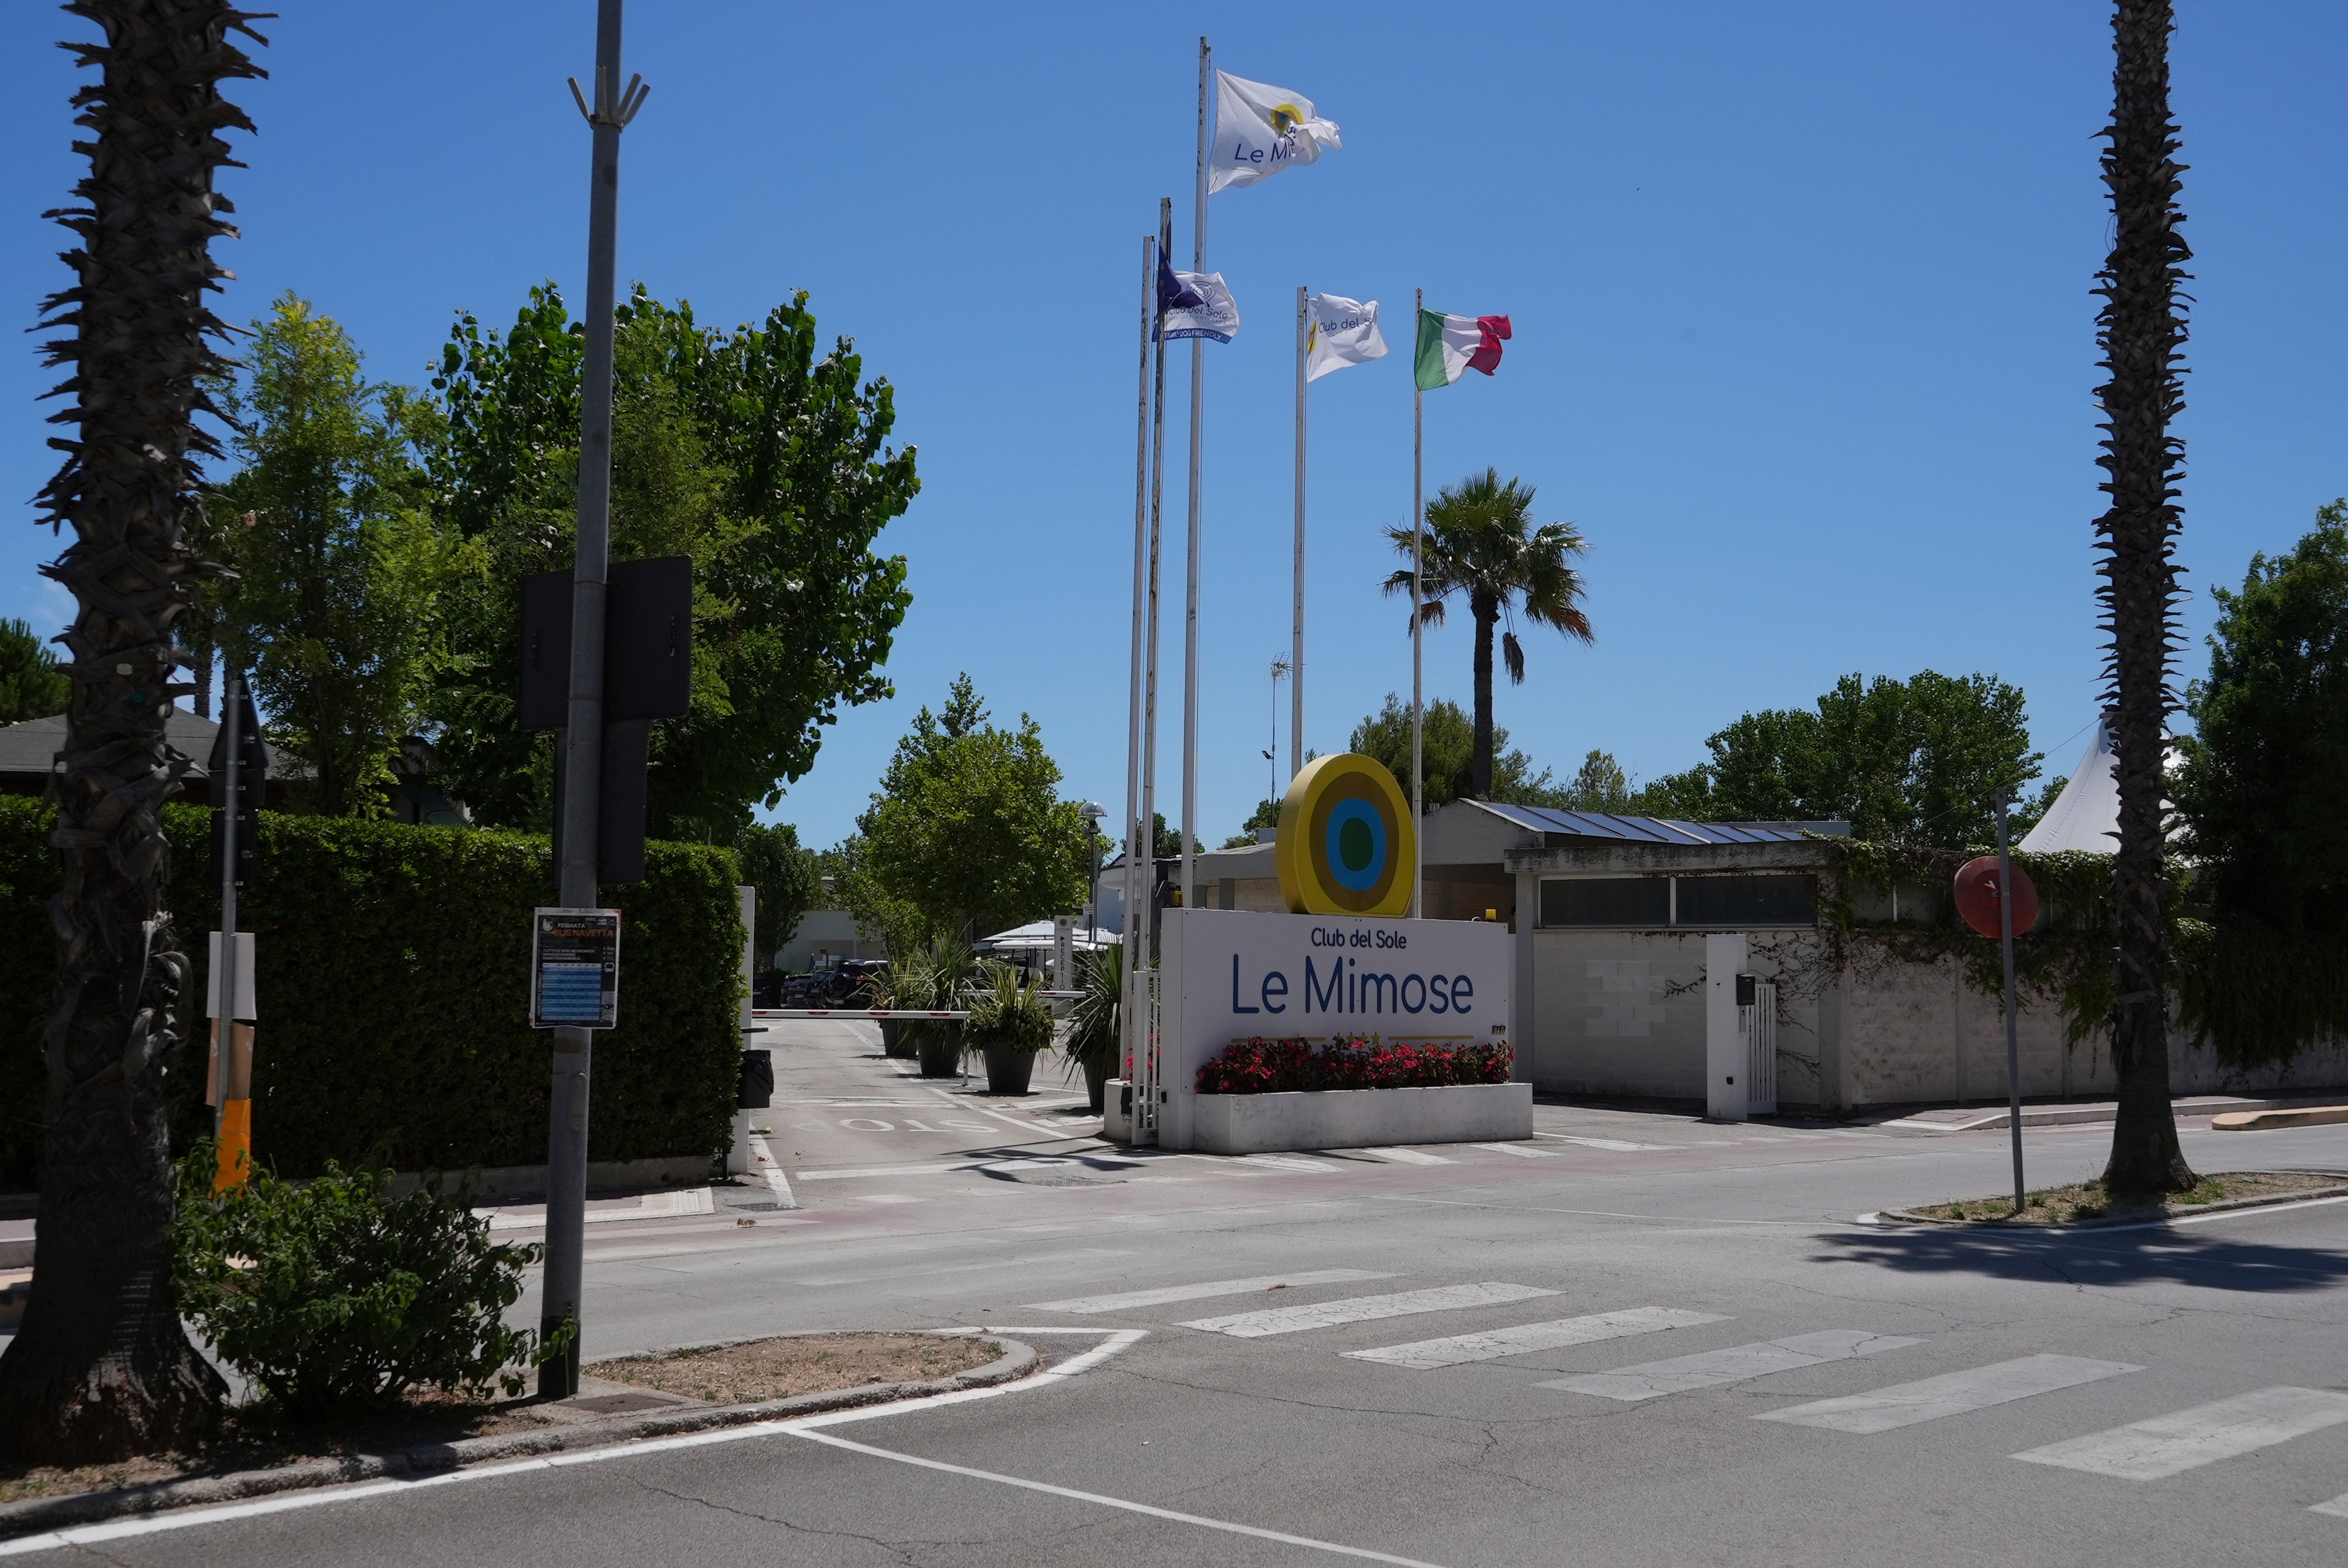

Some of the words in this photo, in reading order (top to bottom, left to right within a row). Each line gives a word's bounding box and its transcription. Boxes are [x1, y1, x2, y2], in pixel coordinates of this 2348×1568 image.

[1234, 143, 1264, 163] Le
[1188, 306, 1203, 315] del
[1206, 308, 1228, 320] Sole
[1318, 320, 1337, 333] Club
[1341, 317, 1360, 329] del
[1192, 330, 1222, 340] FRIENDLY
[572, 929, 614, 937] NAVETTA
[1311, 927, 1345, 947] Club
[1350, 929, 1372, 948] del
[1376, 930, 1407, 949] Sole
[1233, 954, 1288, 1013] Le
[1305, 955, 1473, 1014] Mimose
